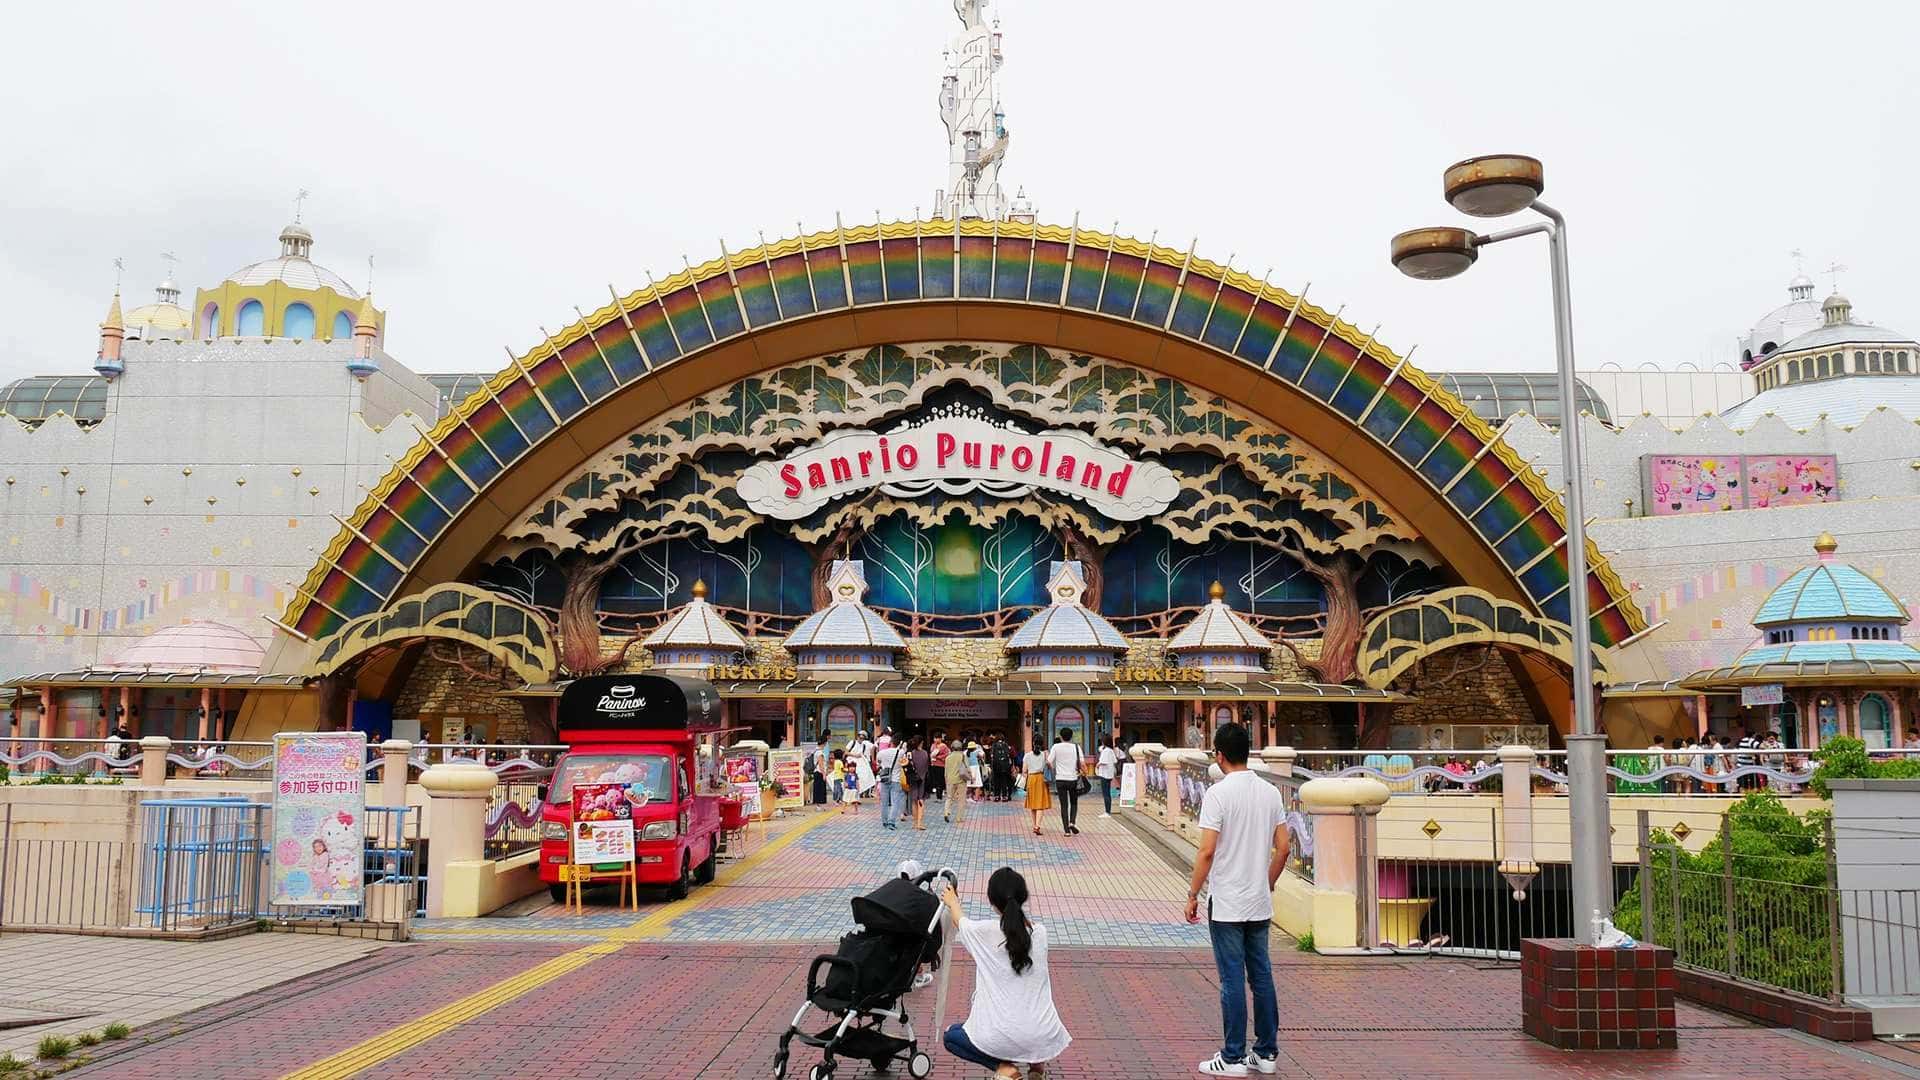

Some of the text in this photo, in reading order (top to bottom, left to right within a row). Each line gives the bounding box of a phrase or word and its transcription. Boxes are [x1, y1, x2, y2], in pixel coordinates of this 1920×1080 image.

[780, 432, 1135, 499] Sanrio Puroland
[707, 665, 798, 680] TICKETS
[1114, 667, 1205, 682] TICKETS
[596, 695, 647, 710] Paninox
[280, 781, 359, 794] 参加受付中!!
